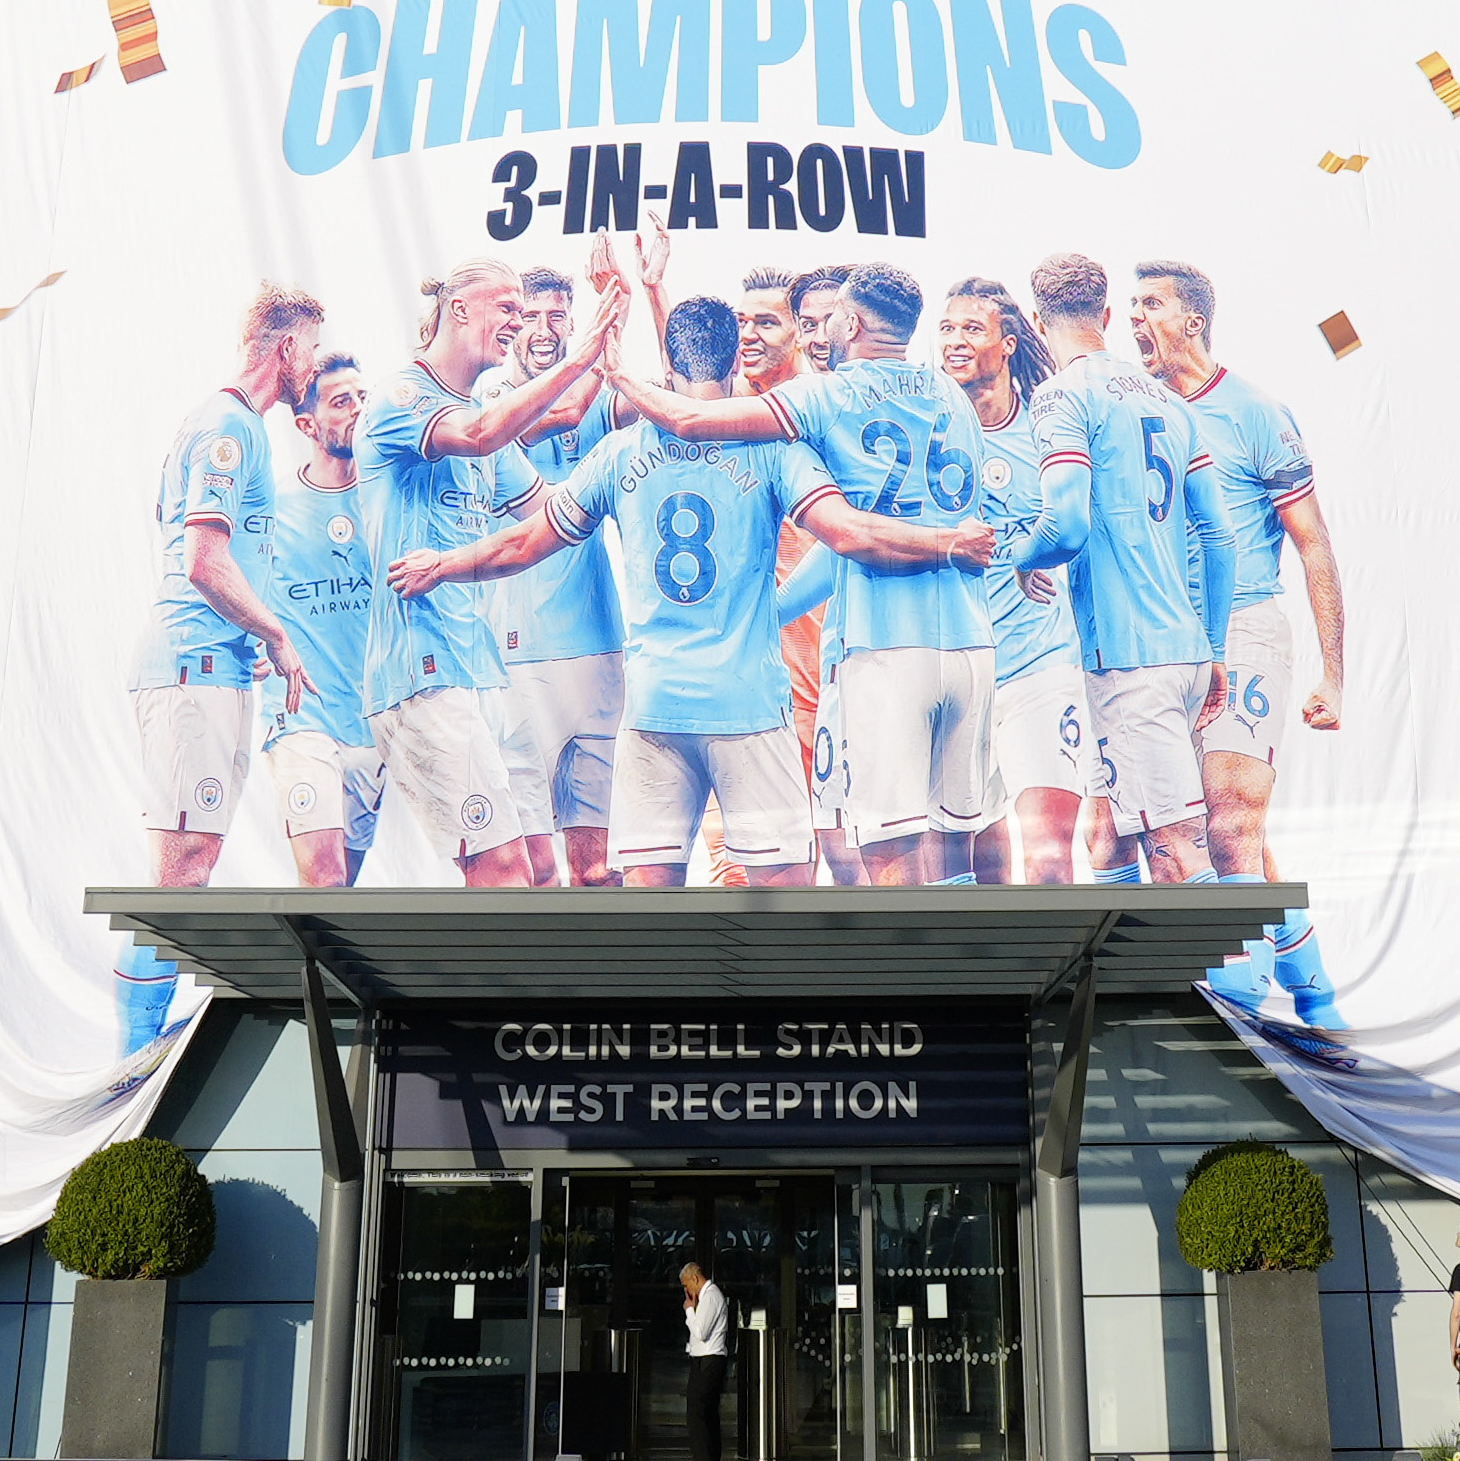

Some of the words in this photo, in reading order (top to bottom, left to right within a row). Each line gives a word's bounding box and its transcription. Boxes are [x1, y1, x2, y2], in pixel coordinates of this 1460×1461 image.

[486, 140, 927, 242] 3-IN-A-ROW
[861, 373, 947, 410] MAHR
[1106, 376, 1168, 403] STONES
[619, 441, 760, 496] GÜNDOĞAN
[860, 412, 975, 519] 26
[1140, 416, 1174, 523] 5
[653, 491, 719, 606] 8
[1059, 705, 1080, 748] 6
[493, 1022, 631, 1061] COLIN
[648, 1022, 762, 1059] BELL
[776, 1020, 924, 1058] STAND
[498, 1083, 634, 1123] WEST
[650, 1081, 919, 1122] RECEPTION
